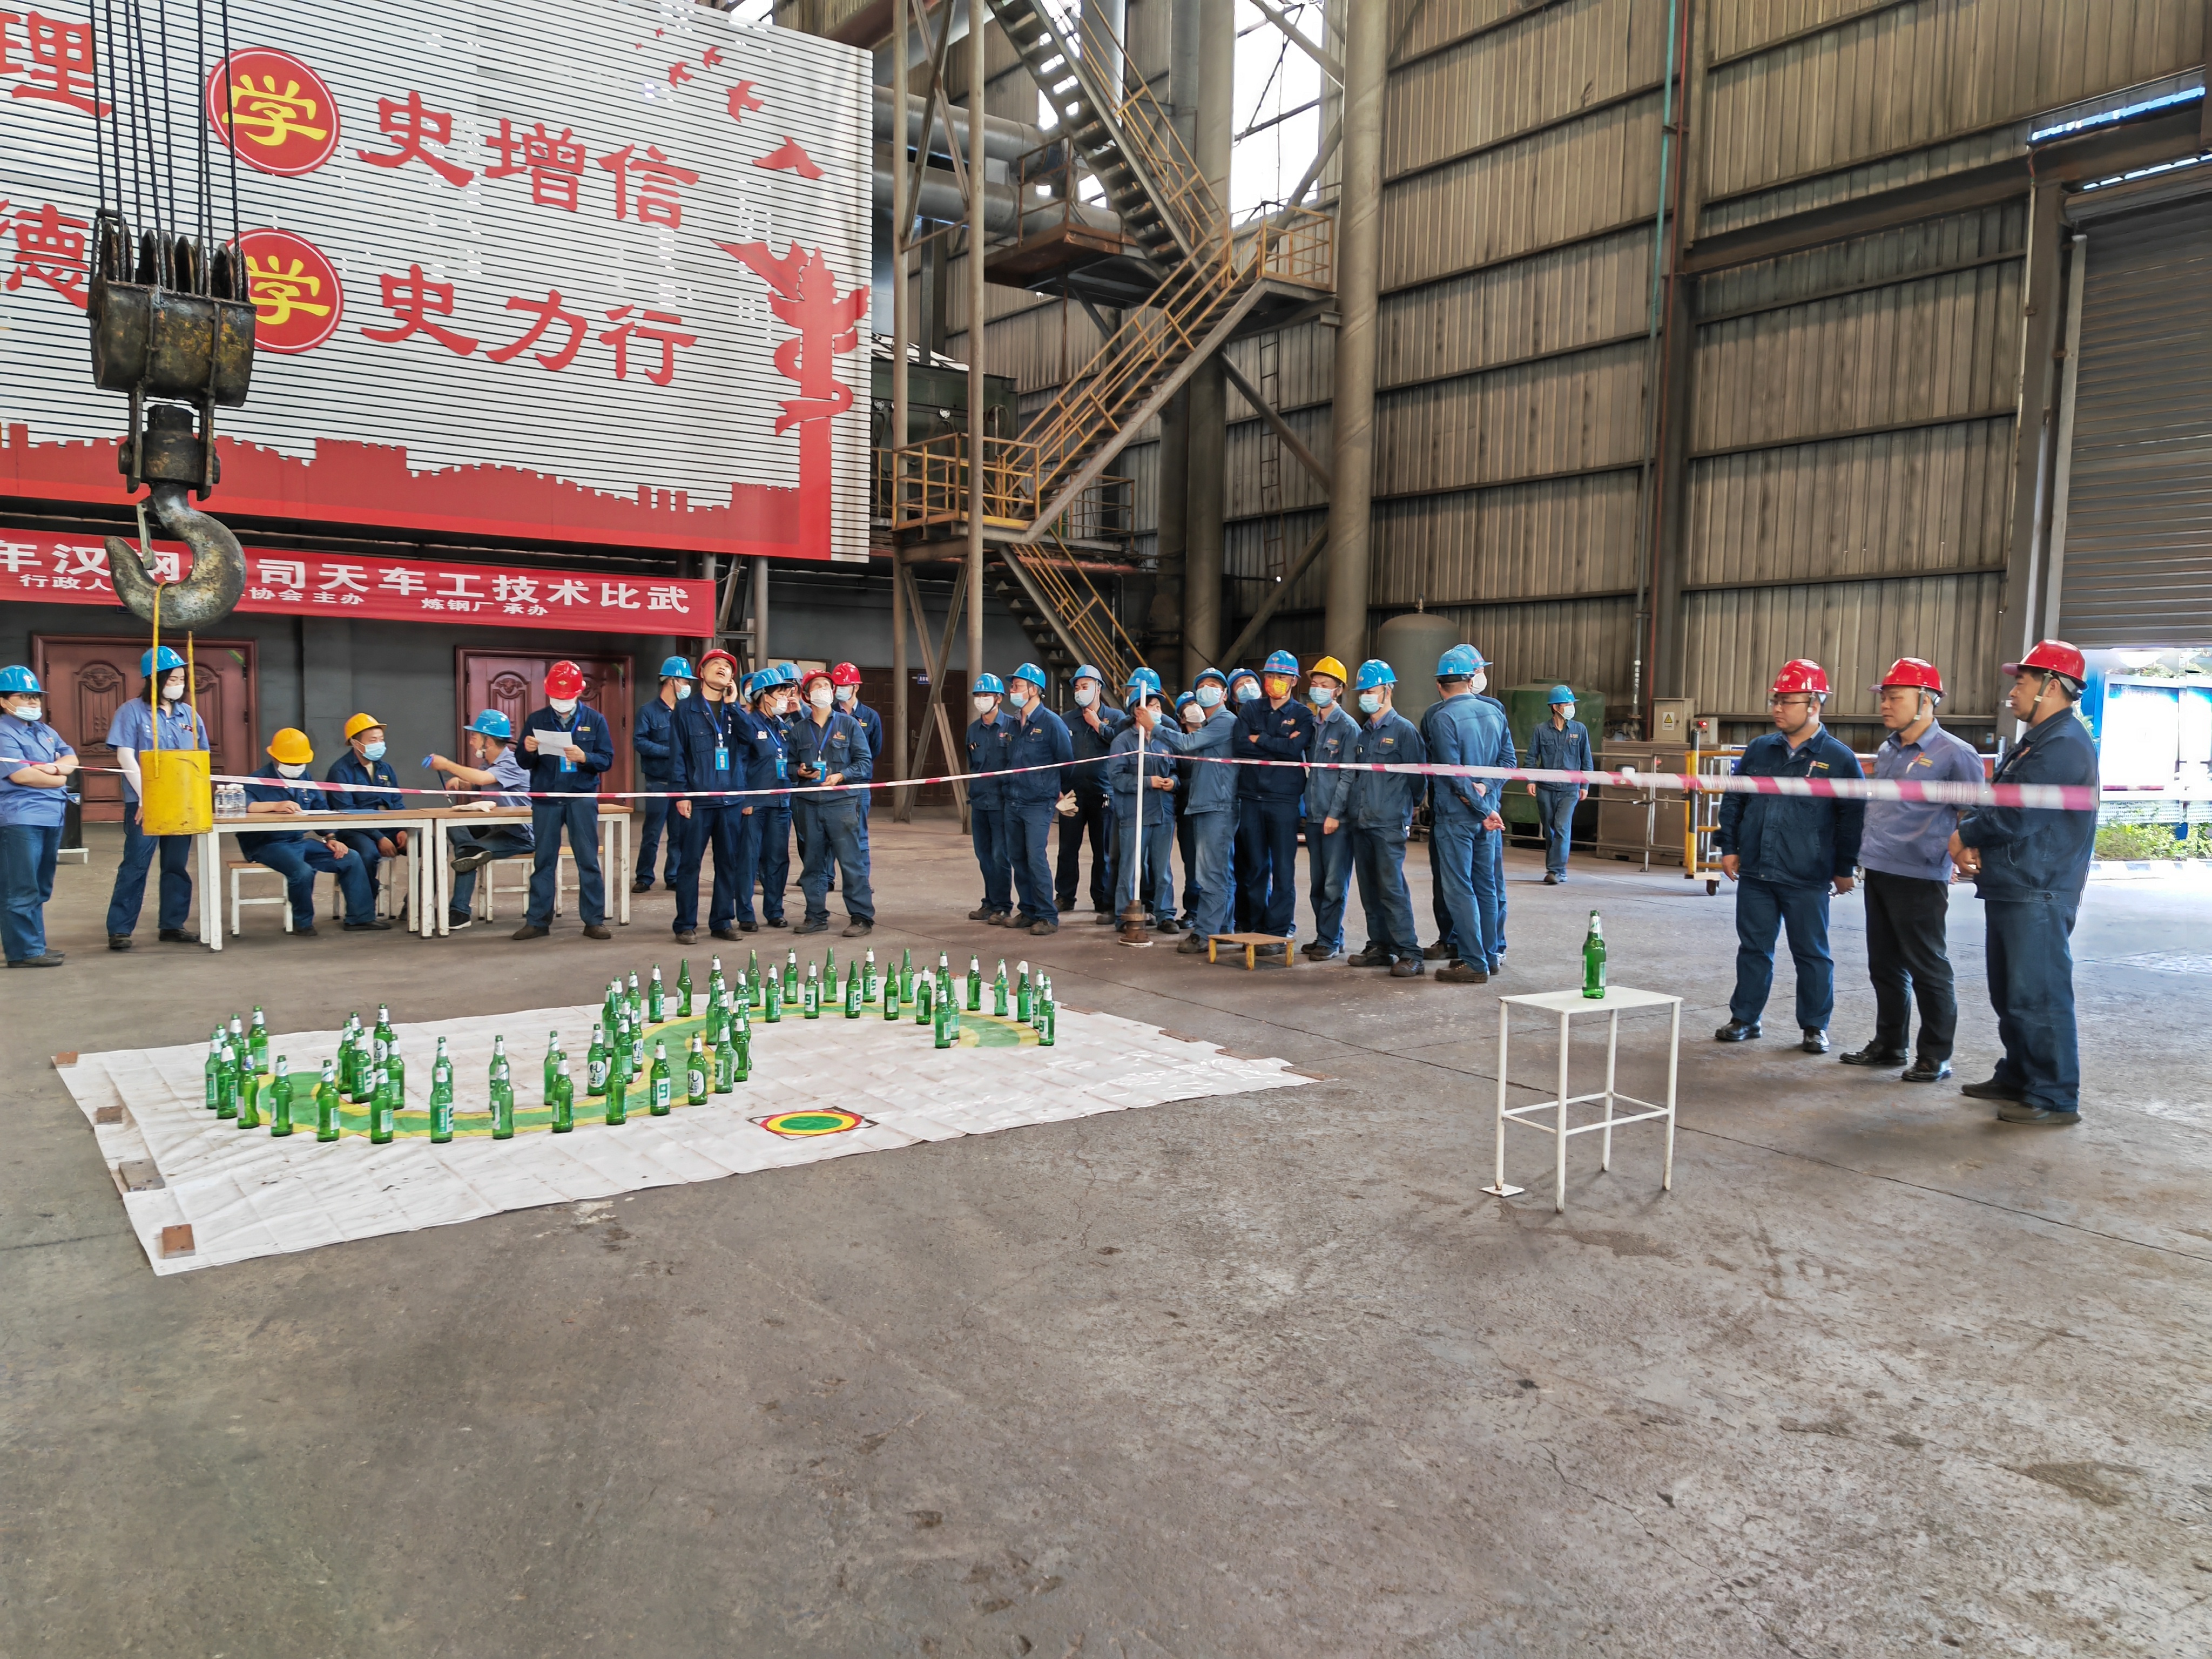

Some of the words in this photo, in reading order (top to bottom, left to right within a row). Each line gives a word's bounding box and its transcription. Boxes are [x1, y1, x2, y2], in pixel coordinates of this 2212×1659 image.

[0, 539, 690, 613] 年汉钢司天车工技术比武
